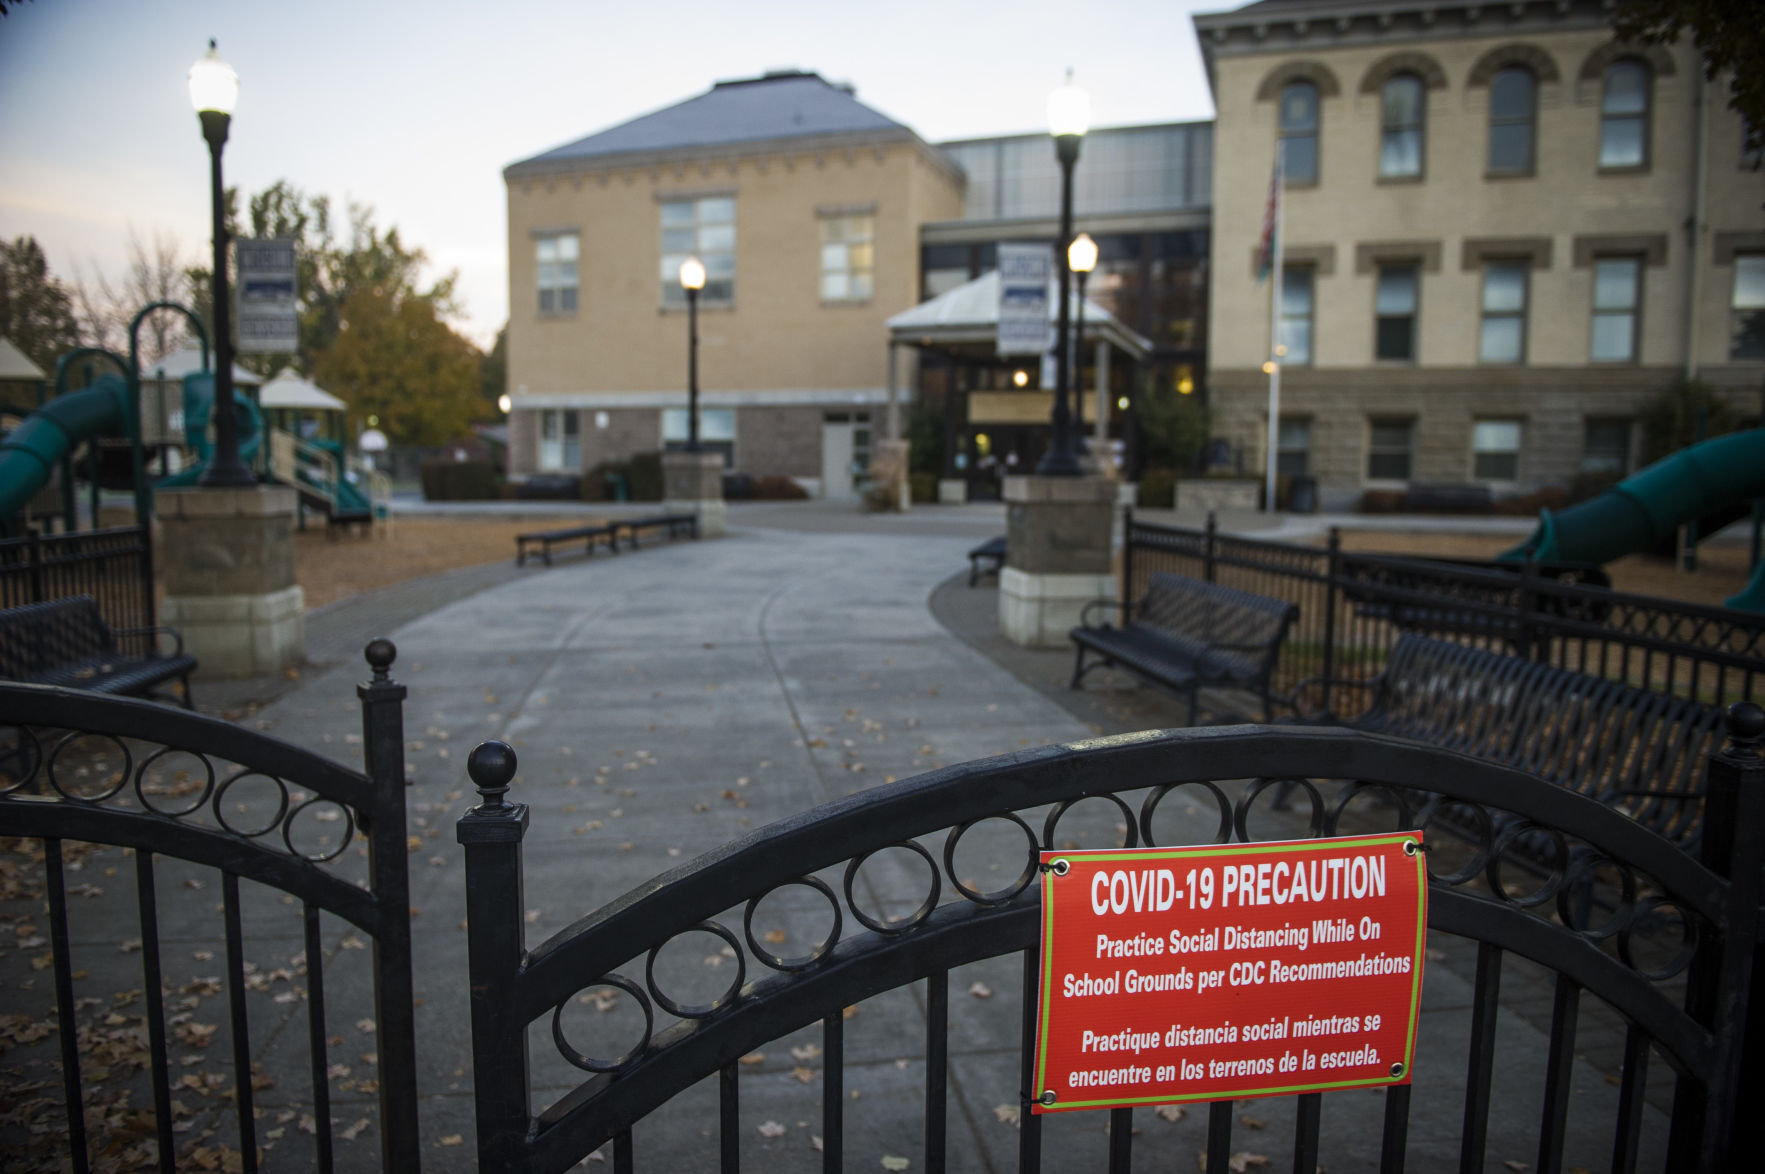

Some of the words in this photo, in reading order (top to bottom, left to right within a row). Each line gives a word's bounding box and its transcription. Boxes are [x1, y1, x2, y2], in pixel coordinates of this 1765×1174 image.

[1091, 866, 1215, 916] COVID-19
[1221, 854, 1386, 908] PRECAUTION
[1096, 931, 1165, 959] Practice
[1168, 927, 1220, 955] Social
[1223, 922, 1309, 951] Distancing
[1312, 918, 1355, 944] While
[1359, 915, 1381, 941] On
[1063, 970, 1120, 998] School
[1124, 966, 1194, 994] Grounds
[1197, 970, 1226, 995] per
[1229, 960, 1266, 987] CDC
[1269, 951, 1411, 984] Recommendations
[1081, 1027, 1161, 1055] Practique
[1164, 1020, 1238, 1048] distancia
[1241, 1016, 1289, 1042] social
[1292, 1014, 1360, 1038] mientras
[1363, 1014, 1381, 1032] se
[1068, 1064, 1152, 1088] encuentre
[1155, 1065, 1176, 1082] en
[1180, 1058, 1205, 1081] los
[1208, 1057, 1275, 1079] terrenos
[1278, 1050, 1298, 1073] de
[1301, 1048, 1316, 1071] la
[1320, 1043, 1381, 1069] escuela.
